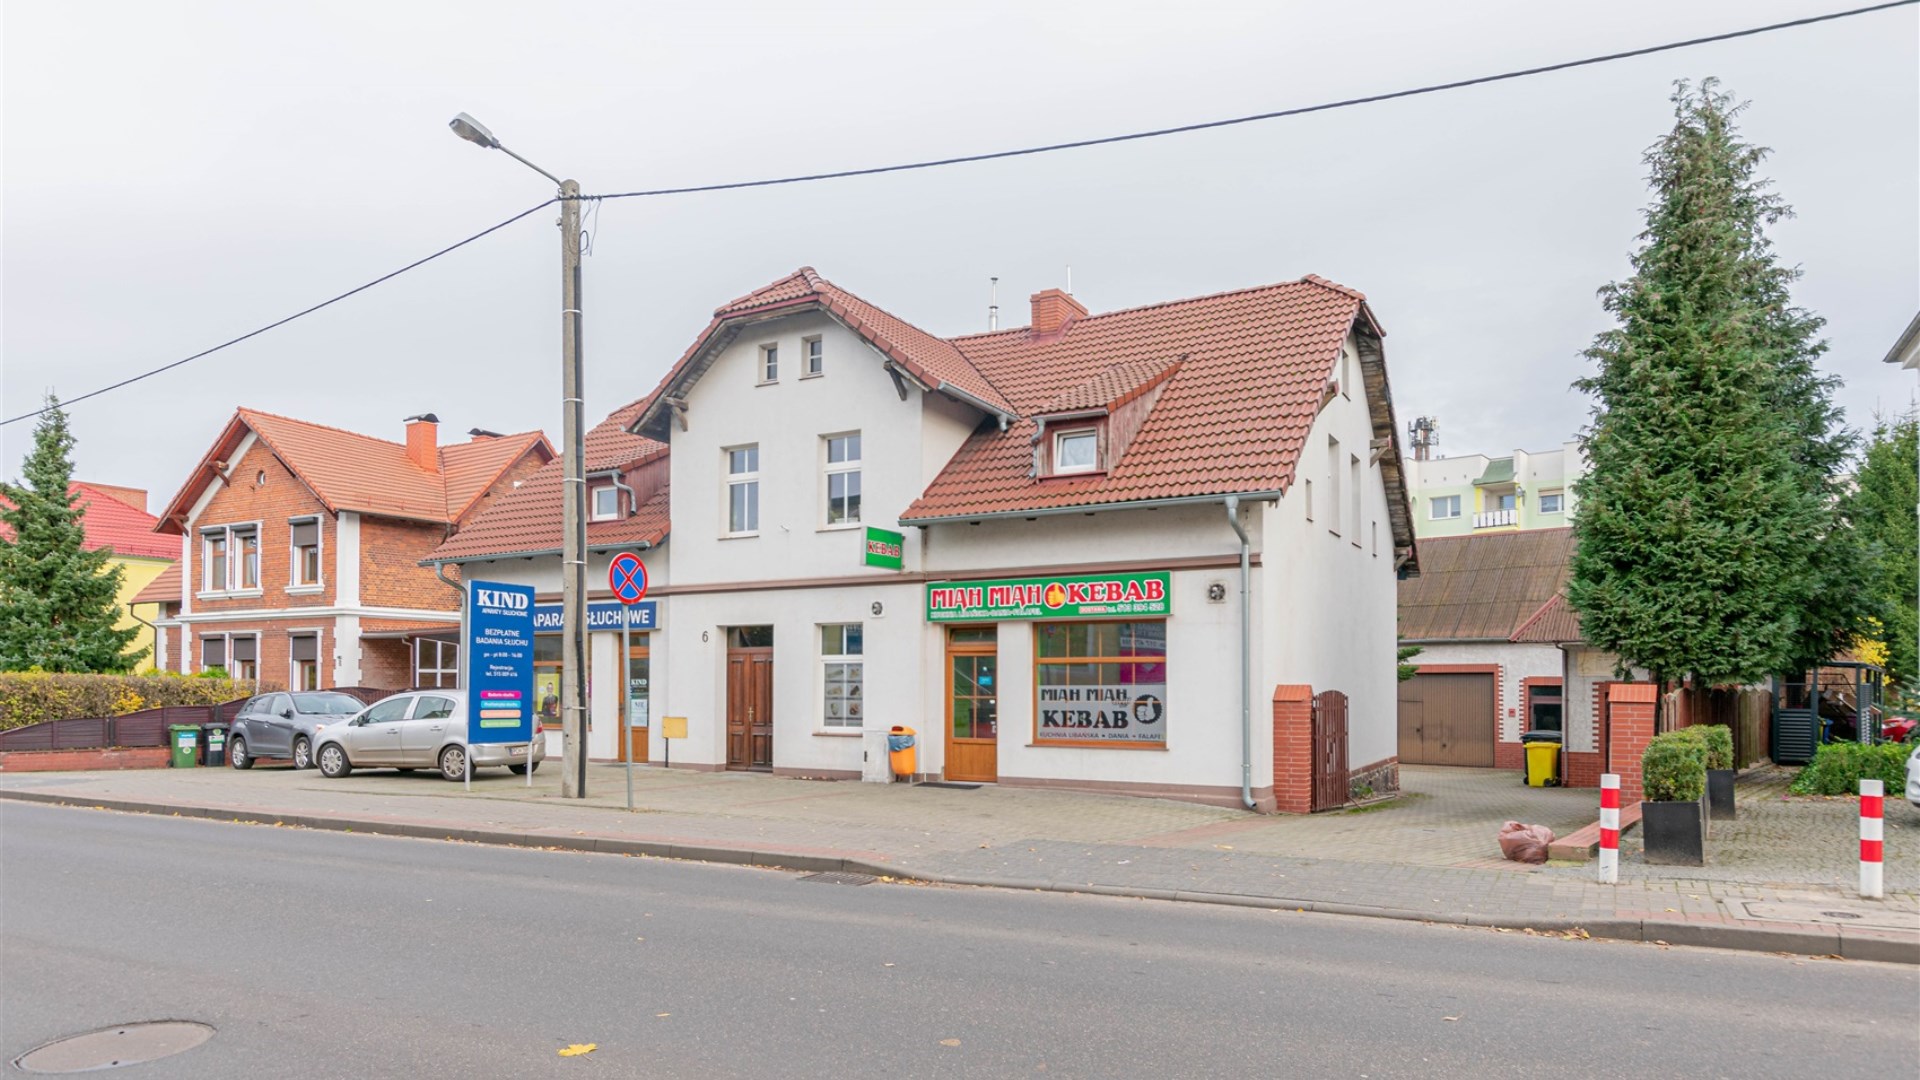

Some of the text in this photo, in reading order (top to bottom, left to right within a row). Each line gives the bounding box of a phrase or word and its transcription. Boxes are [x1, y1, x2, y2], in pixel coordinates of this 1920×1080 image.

[867, 540, 901, 558] KEBAB
[477, 589, 529, 610] KIND
[931, 579, 1165, 610] MIAH MIAH KEBAB
[586, 609, 650, 625] SŁUCHWE
[485, 628, 520, 637] BEZPŁATNE
[702, 630, 709, 643] 6
[476, 637, 529, 647] BADANIA SŁUCHU
[1041, 688, 1080, 702] MIAH
[1086, 688, 1128, 702] MIAH
[1042, 710, 1129, 729] KEBAB
